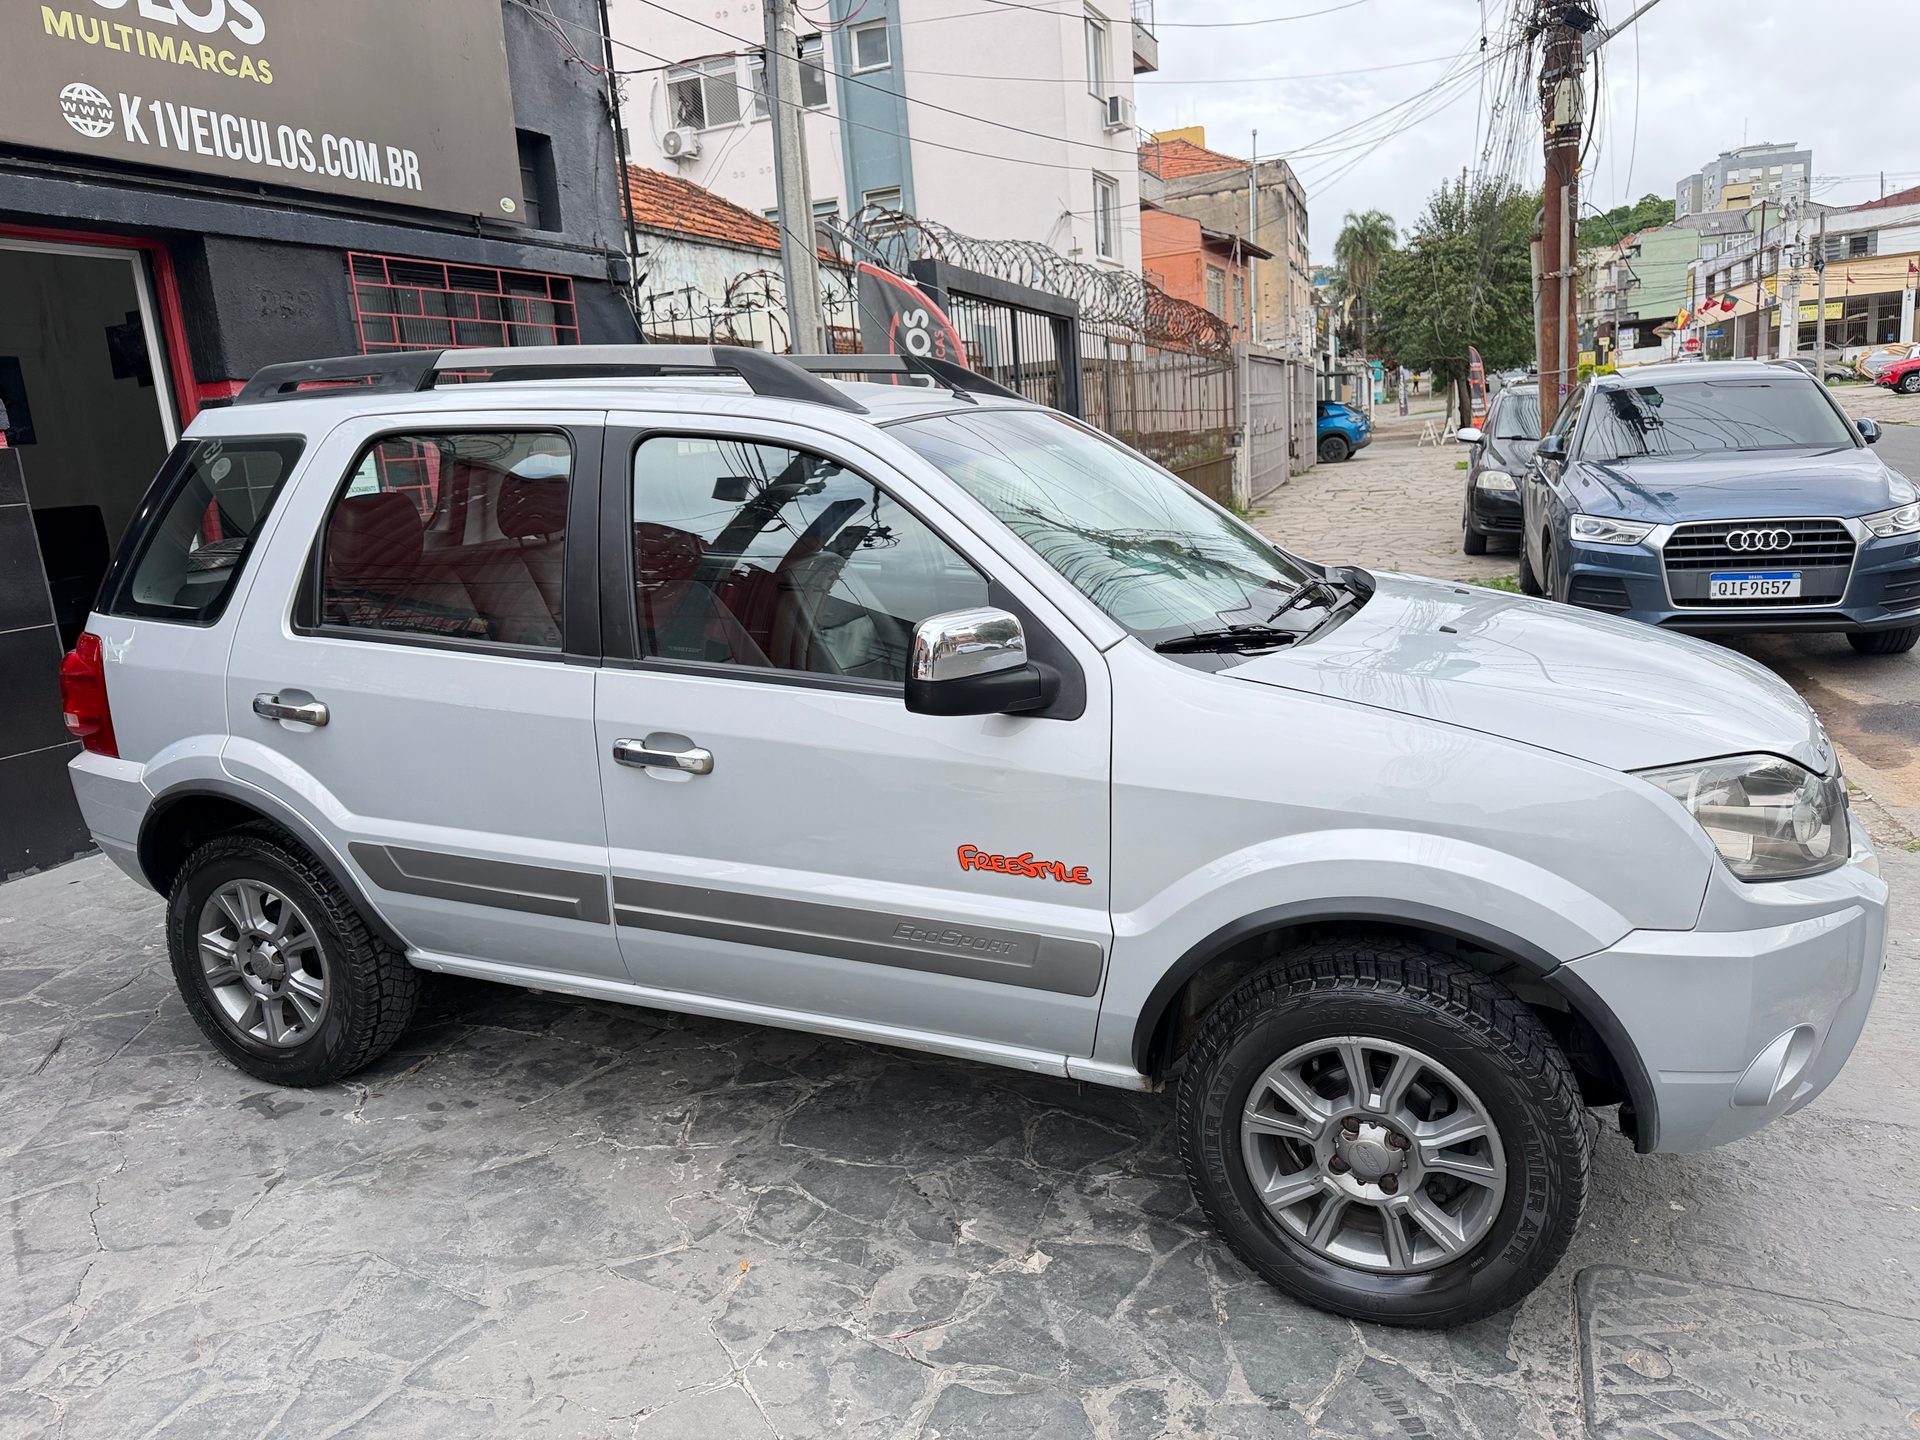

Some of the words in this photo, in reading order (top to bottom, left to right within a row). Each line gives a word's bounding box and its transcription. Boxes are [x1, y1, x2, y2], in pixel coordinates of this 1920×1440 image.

[92, 0, 267, 45] LOS
[41, 5, 274, 85] MULTIMARCAS
[118, 92, 423, 191] K1VEICULOS.COM.BR
[934, 330, 946, 360] CAS
[1718, 580, 1792, 596] QIF9G57
[957, 844, 1093, 885] FREESTYLE
